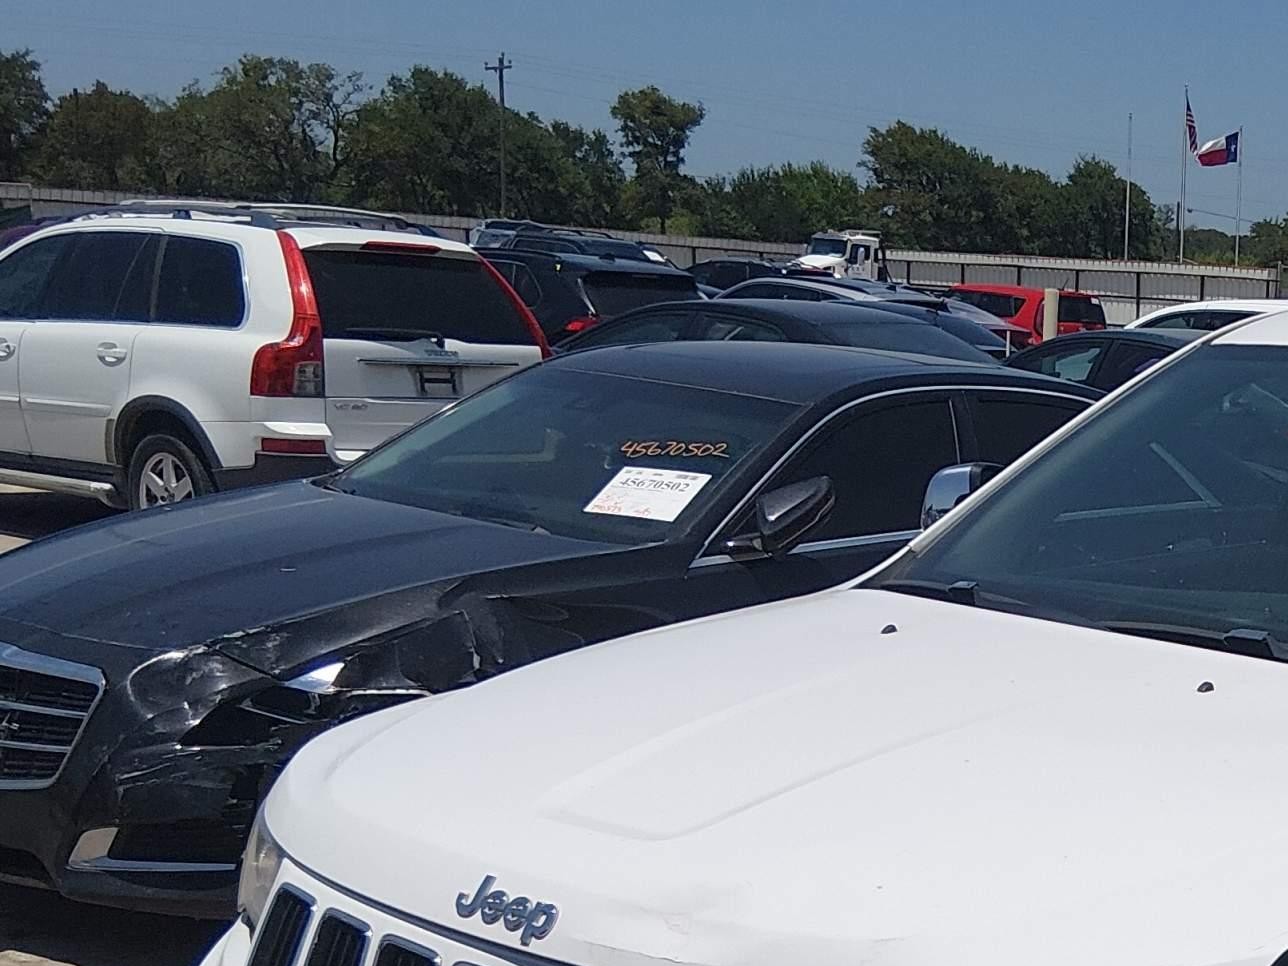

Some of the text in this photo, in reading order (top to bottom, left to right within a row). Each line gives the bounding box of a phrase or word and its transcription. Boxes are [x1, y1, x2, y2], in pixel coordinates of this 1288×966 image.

[620, 440, 730, 459] 45670502
[619, 477, 691, 493] 45670502
[455, 874, 560, 947] Jeep
